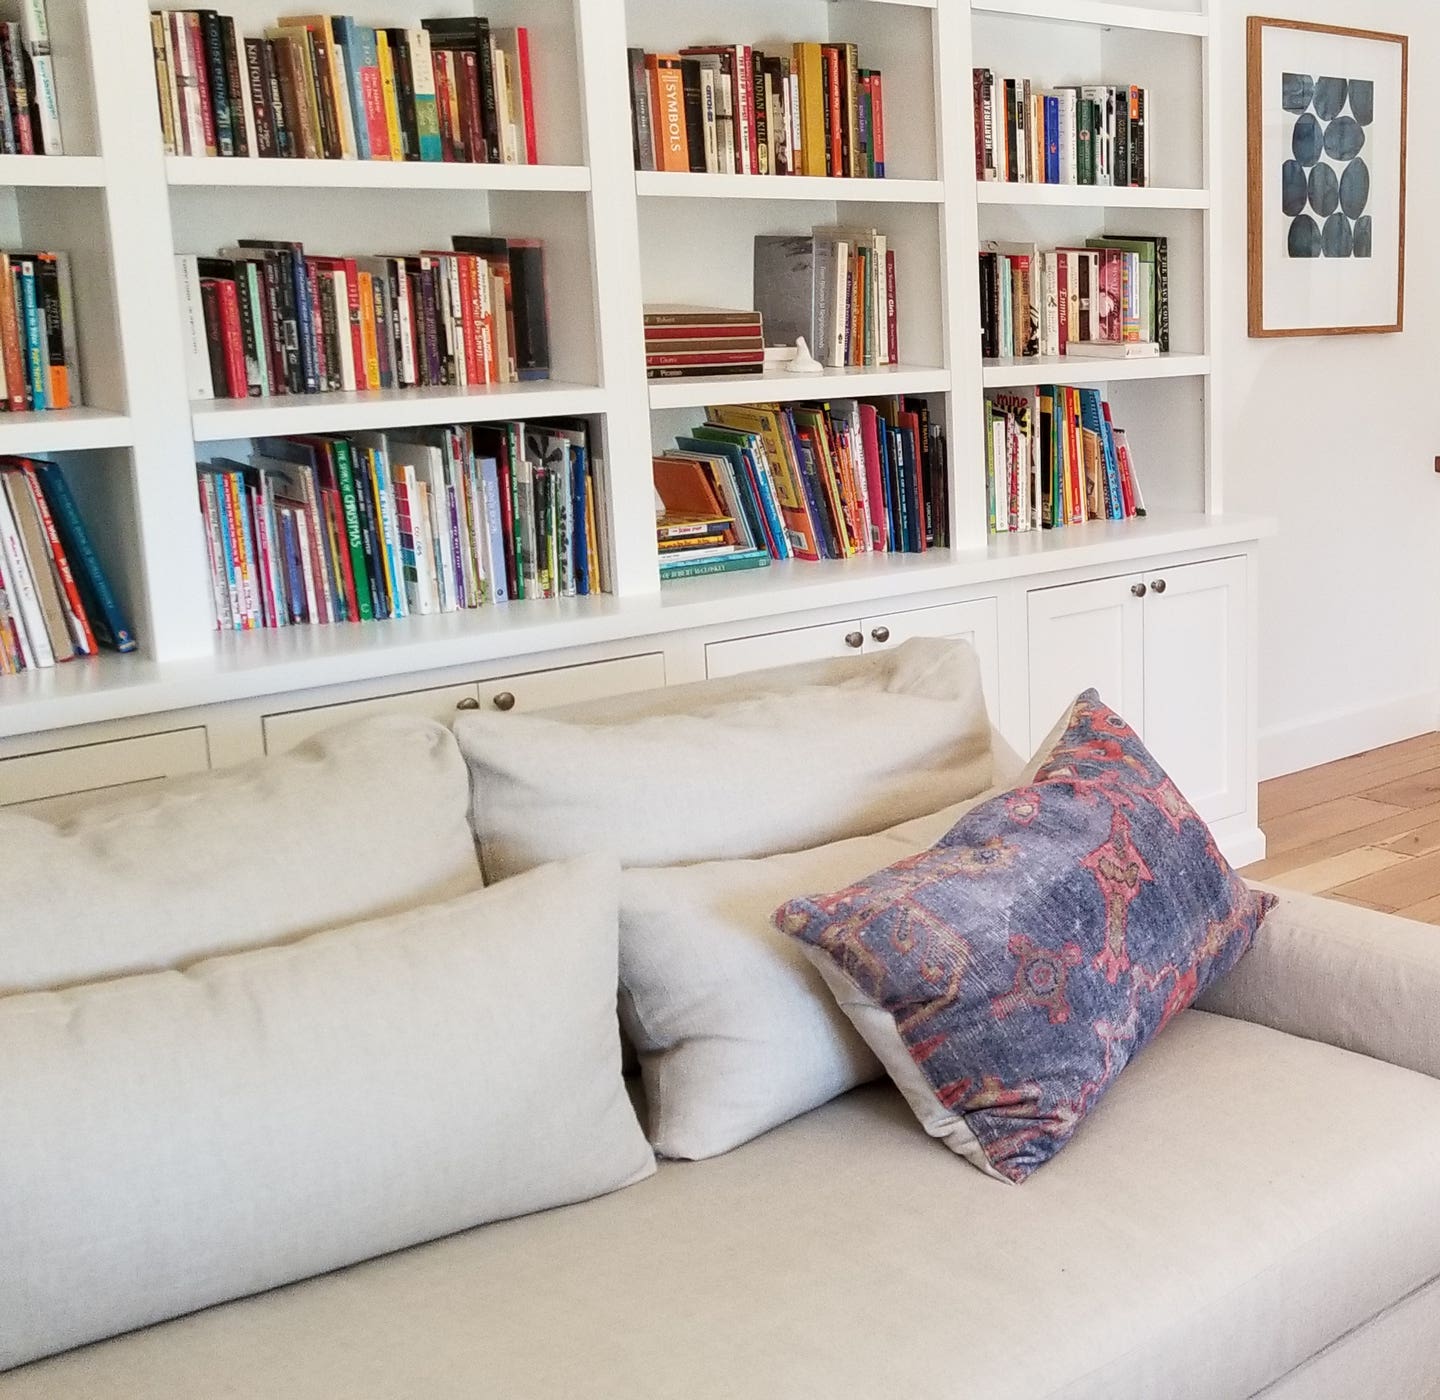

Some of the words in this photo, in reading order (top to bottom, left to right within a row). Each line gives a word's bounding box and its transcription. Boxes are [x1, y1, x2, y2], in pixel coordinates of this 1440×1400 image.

[246, 44, 259, 64] KEN
[250, 65, 265, 105] FOLLETT
[754, 74, 764, 109] INDIAN
[666, 84, 681, 152] SYMBOLS
[757, 121, 765, 144] KILL
[983, 100, 993, 149] HEARTBREAK
[1059, 287, 1067, 325] Emma
[997, 394, 1028, 408] mine
[340, 463, 349, 481] STORY
[344, 495, 361, 548] CHRISTMAS
